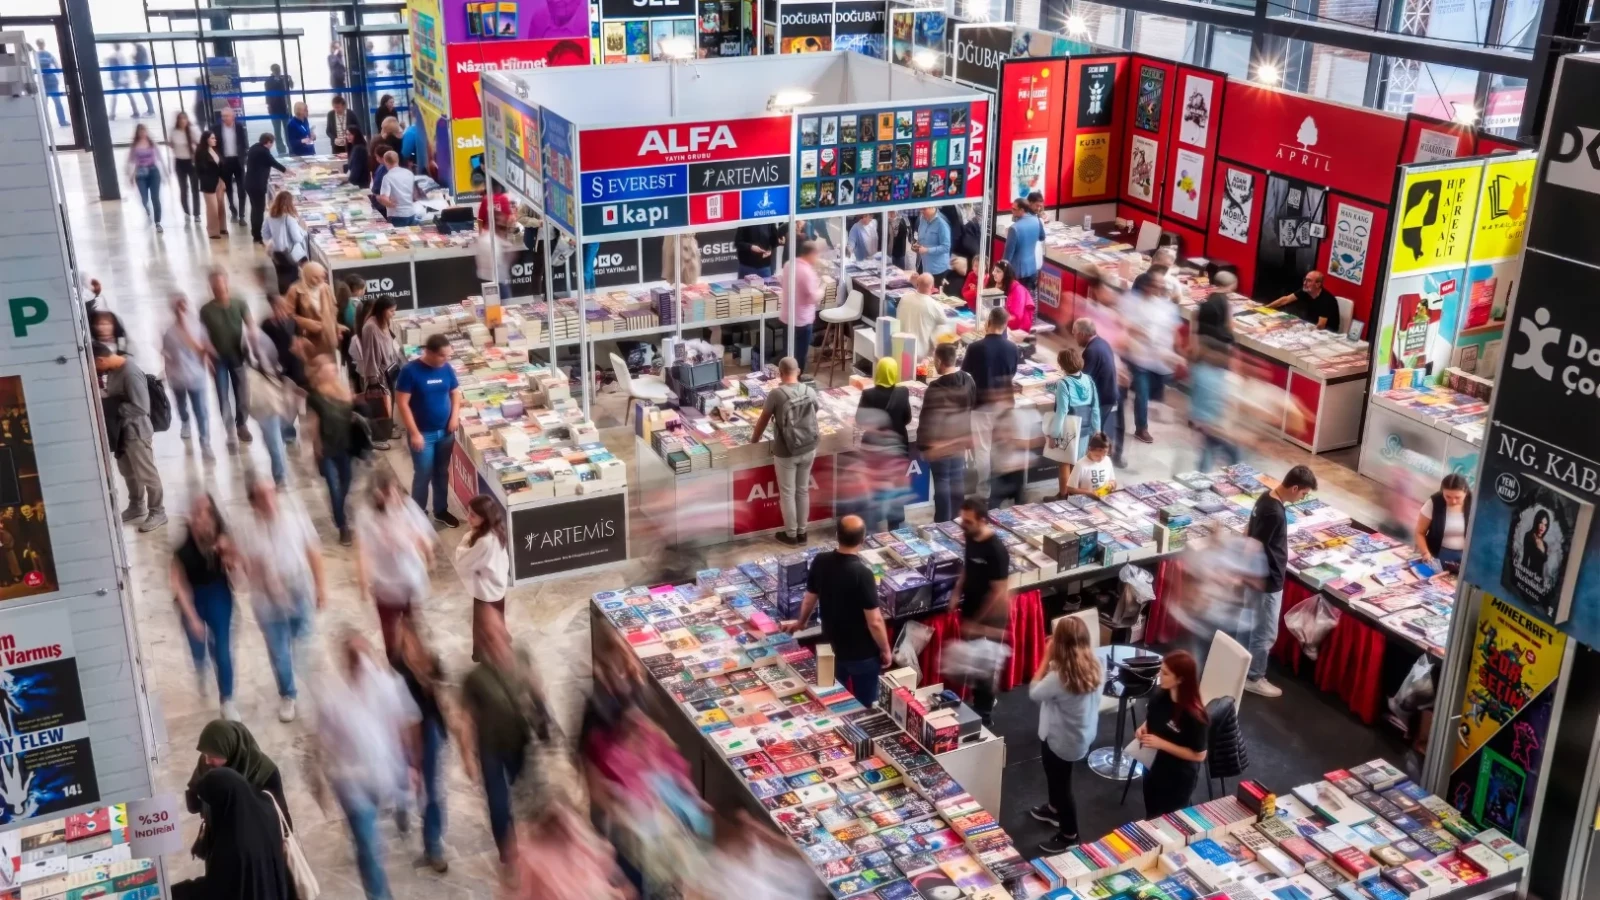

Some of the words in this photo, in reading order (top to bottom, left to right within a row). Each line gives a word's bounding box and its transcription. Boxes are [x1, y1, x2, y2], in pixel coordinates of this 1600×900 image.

[782, 12, 832, 25] DOĞUBATI
[637, 124, 738, 156] ALFA
[967, 120, 984, 180] ALFA
[687, 152, 711, 160] GRUBU
[1276, 148, 1330, 171] APRIL
[715, 162, 779, 187] ARTEMİS
[1233, 176, 1247, 185] ADAM
[622, 203, 669, 227] kapı
[1340, 210, 1353, 219] HAN
[1354, 214, 1369, 223] KANG
[606, 265, 637, 275] YAYINLARI
[376, 290, 410, 299] YNLARI
[9, 297, 49, 337] P
[1562, 365, 1600, 398] Ço
[1497, 433, 1539, 470] N.G.
[1544, 452, 1600, 496] KAB
[747, 474, 819, 502] ALA
[1498, 485, 1516, 499] KİTAP
[1501, 476, 1516, 489] YENİ
[540, 518, 615, 549] ARTEMİS
[1491, 597, 1554, 645] MINECRAFT
[4, 643, 62, 665] Varmış
[19, 727, 64, 752] FLEW
[139, 811, 169, 825] %30
